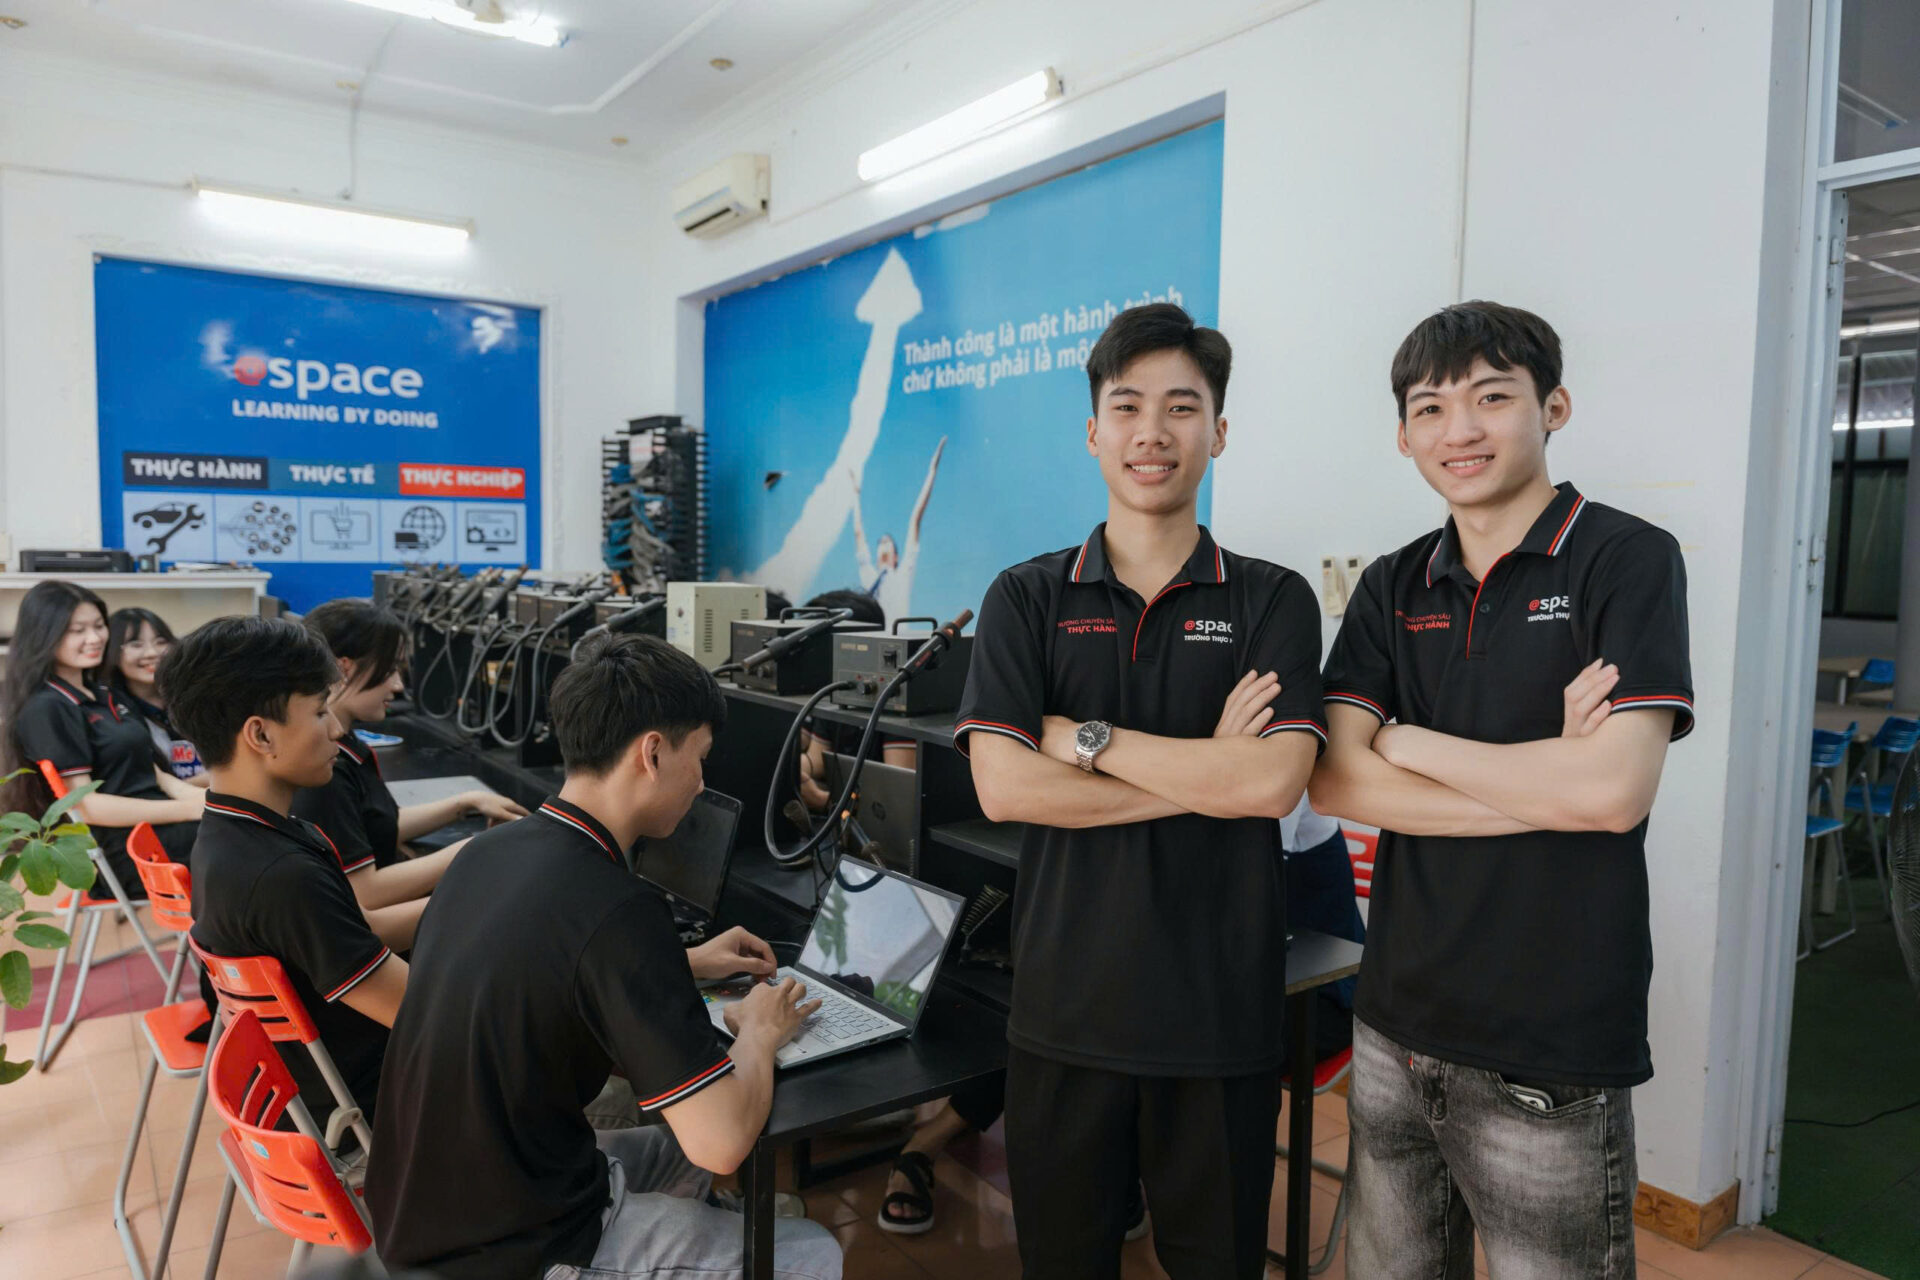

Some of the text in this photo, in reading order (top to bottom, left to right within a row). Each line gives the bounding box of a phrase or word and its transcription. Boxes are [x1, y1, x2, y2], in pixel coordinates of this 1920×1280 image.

[904, 299, 1118, 365] Thành công là một hành
[903, 338, 1096, 394] chứ không phải là mộ
[232, 399, 439, 429] LEARNING BY DOING
[131, 458, 262, 480] THỰC HÀNH
[290, 463, 375, 486] THỰC TẾ
[402, 467, 522, 490] THỰC NGHIỆP
[1184, 619, 1233, 634] @spac
